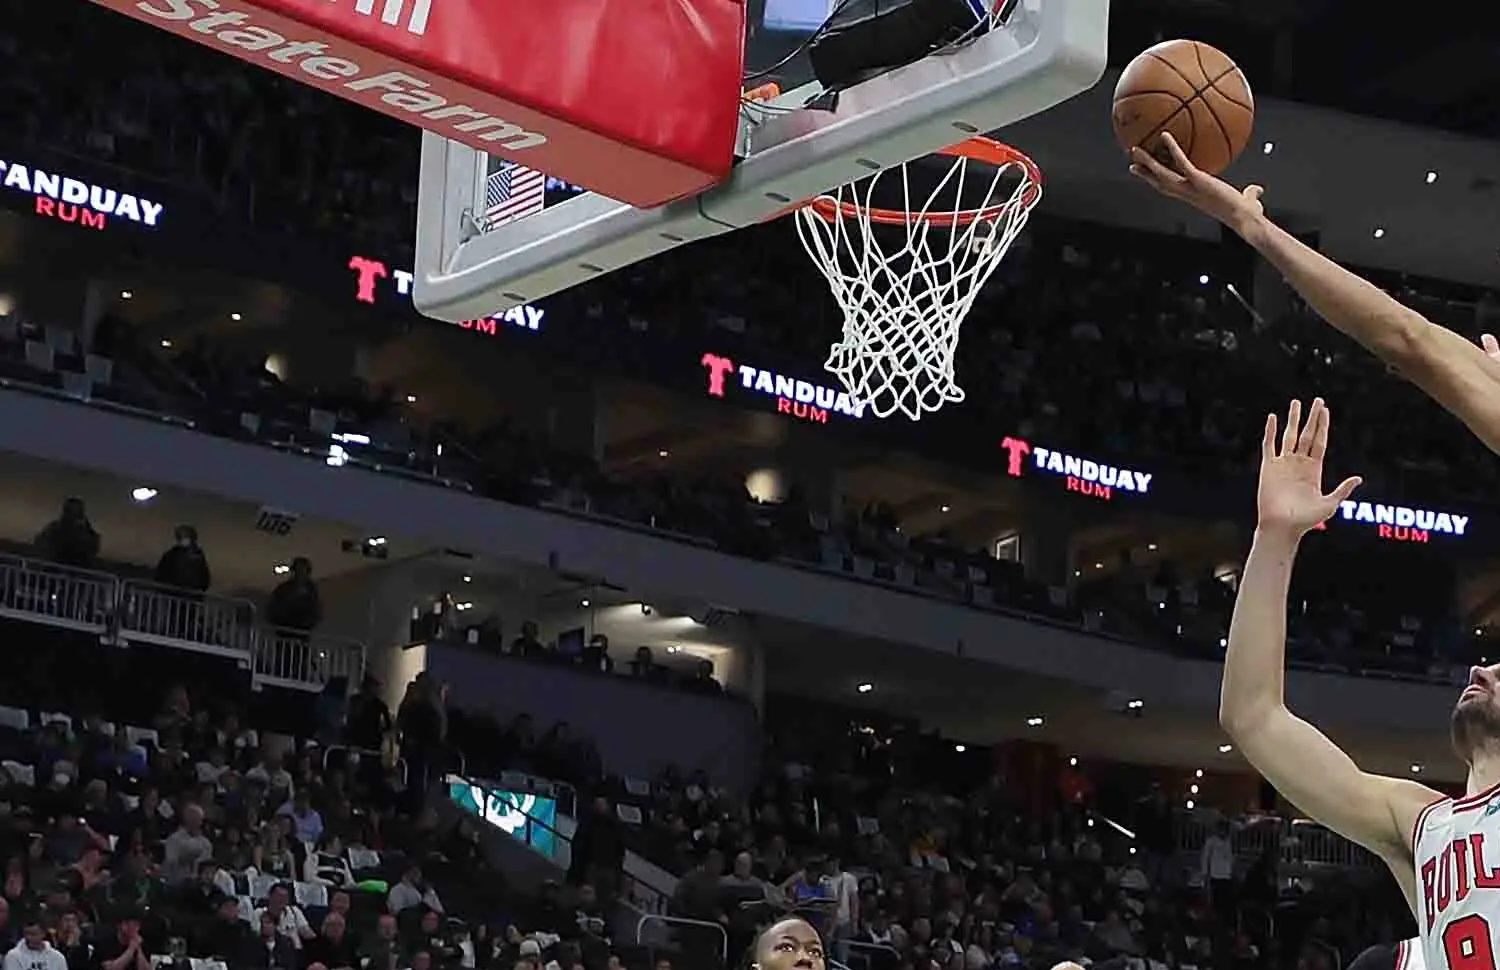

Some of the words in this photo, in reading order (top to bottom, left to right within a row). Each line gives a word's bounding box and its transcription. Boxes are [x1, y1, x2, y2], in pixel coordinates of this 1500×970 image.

[137, 0, 360, 80] State
[344, 71, 548, 150] Farm
[36, 196, 106, 230] RUM
[739, 365, 870, 419] TANDUAY
[777, 397, 831, 424] RUM
[1033, 446, 1153, 493] TANDUAY
[1066, 476, 1112, 500] RUM
[1340, 500, 1469, 535] TANDUAY
[1379, 523, 1429, 543] RUM
